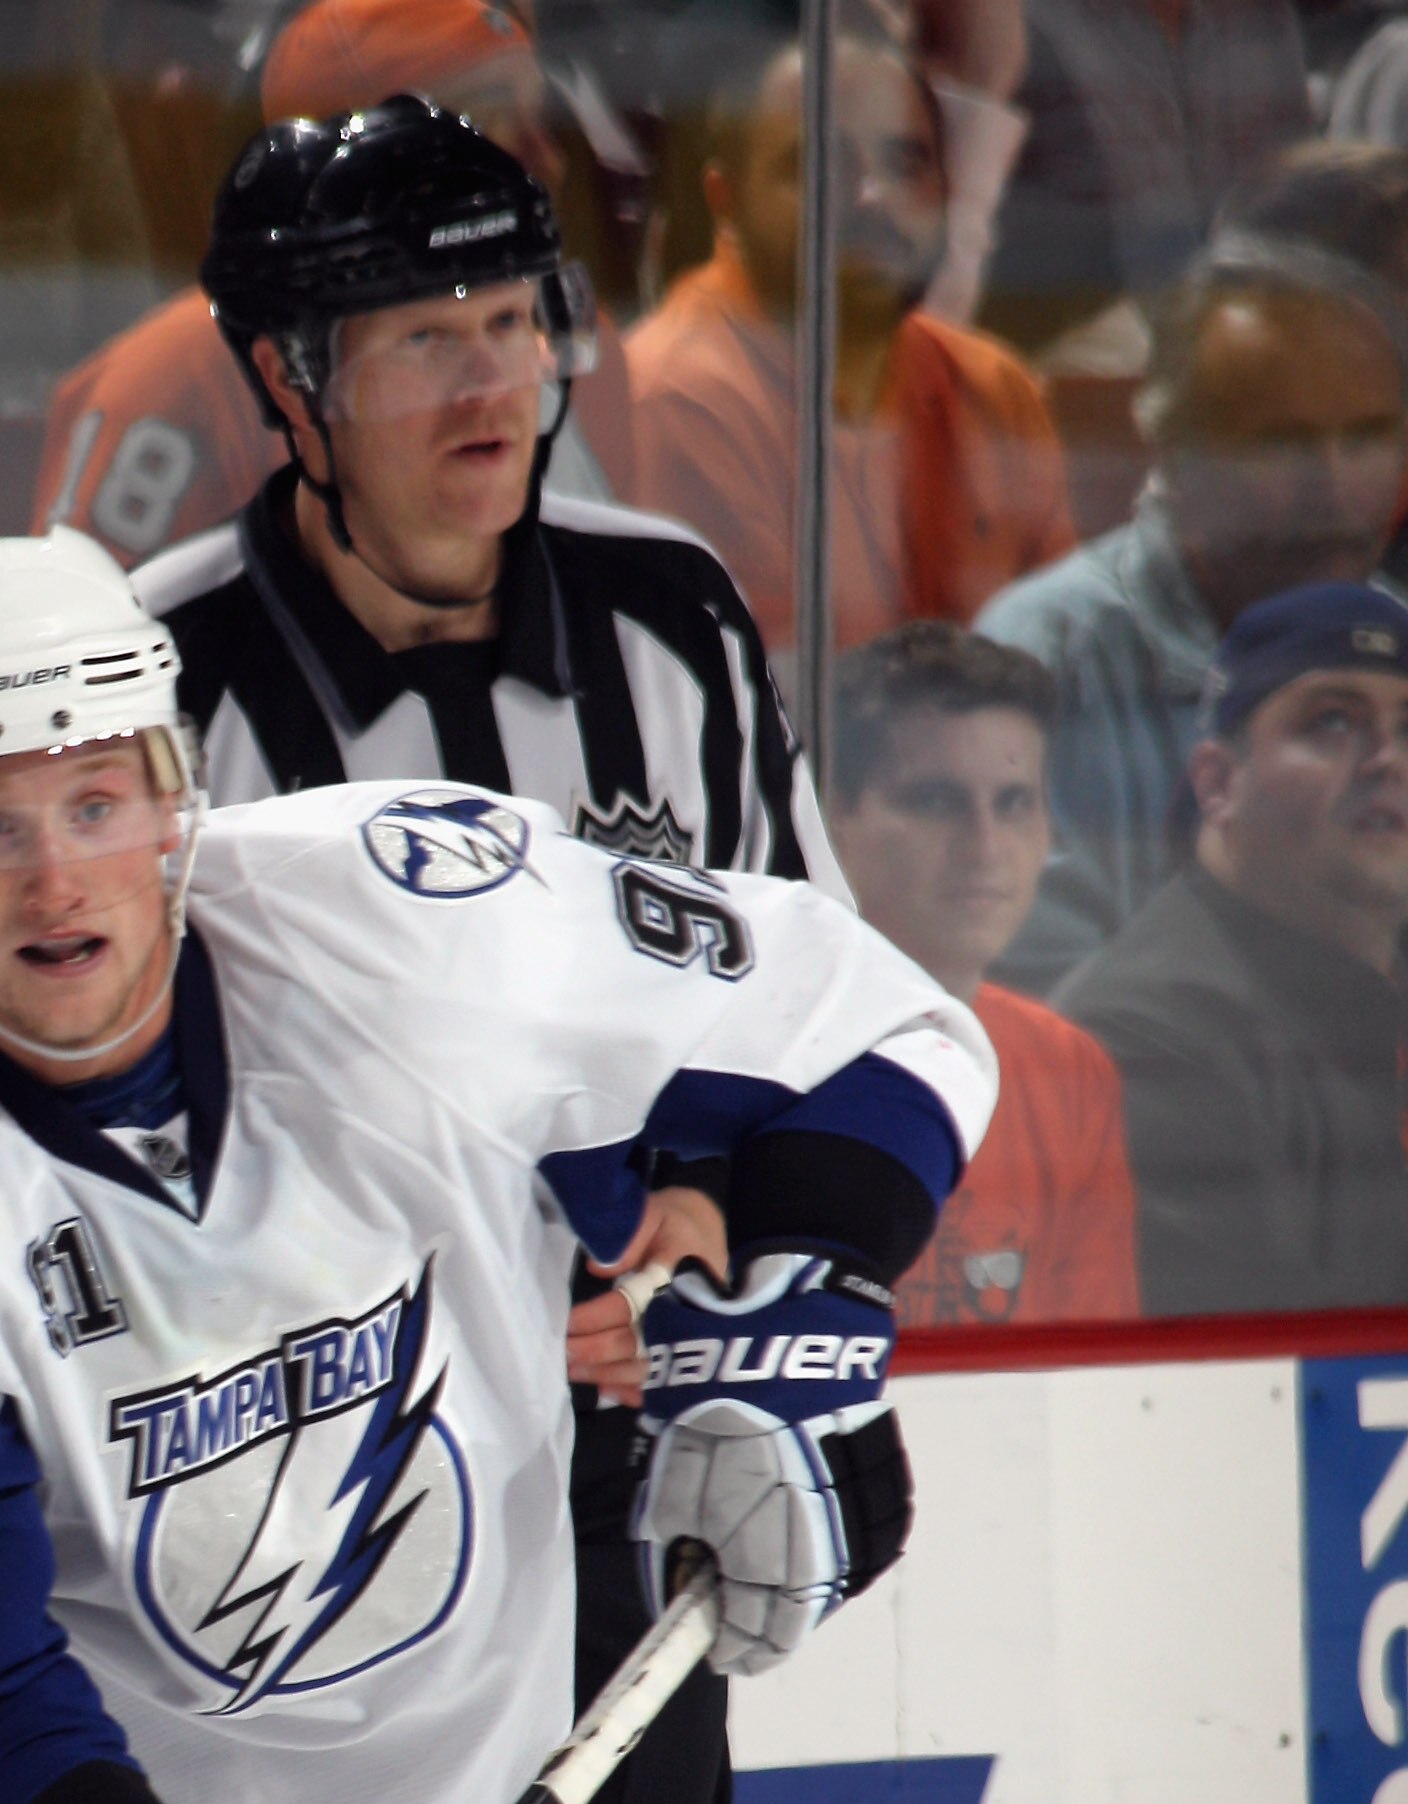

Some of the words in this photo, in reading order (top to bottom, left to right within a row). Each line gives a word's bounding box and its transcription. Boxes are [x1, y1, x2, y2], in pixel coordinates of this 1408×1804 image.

[429, 212, 516, 248] BAUER
[610, 854, 756, 984] 9
[118, 1354, 290, 1488] TAMPA
[291, 1296, 407, 1418] BAY
[642, 1335, 888, 1390] BAUER
